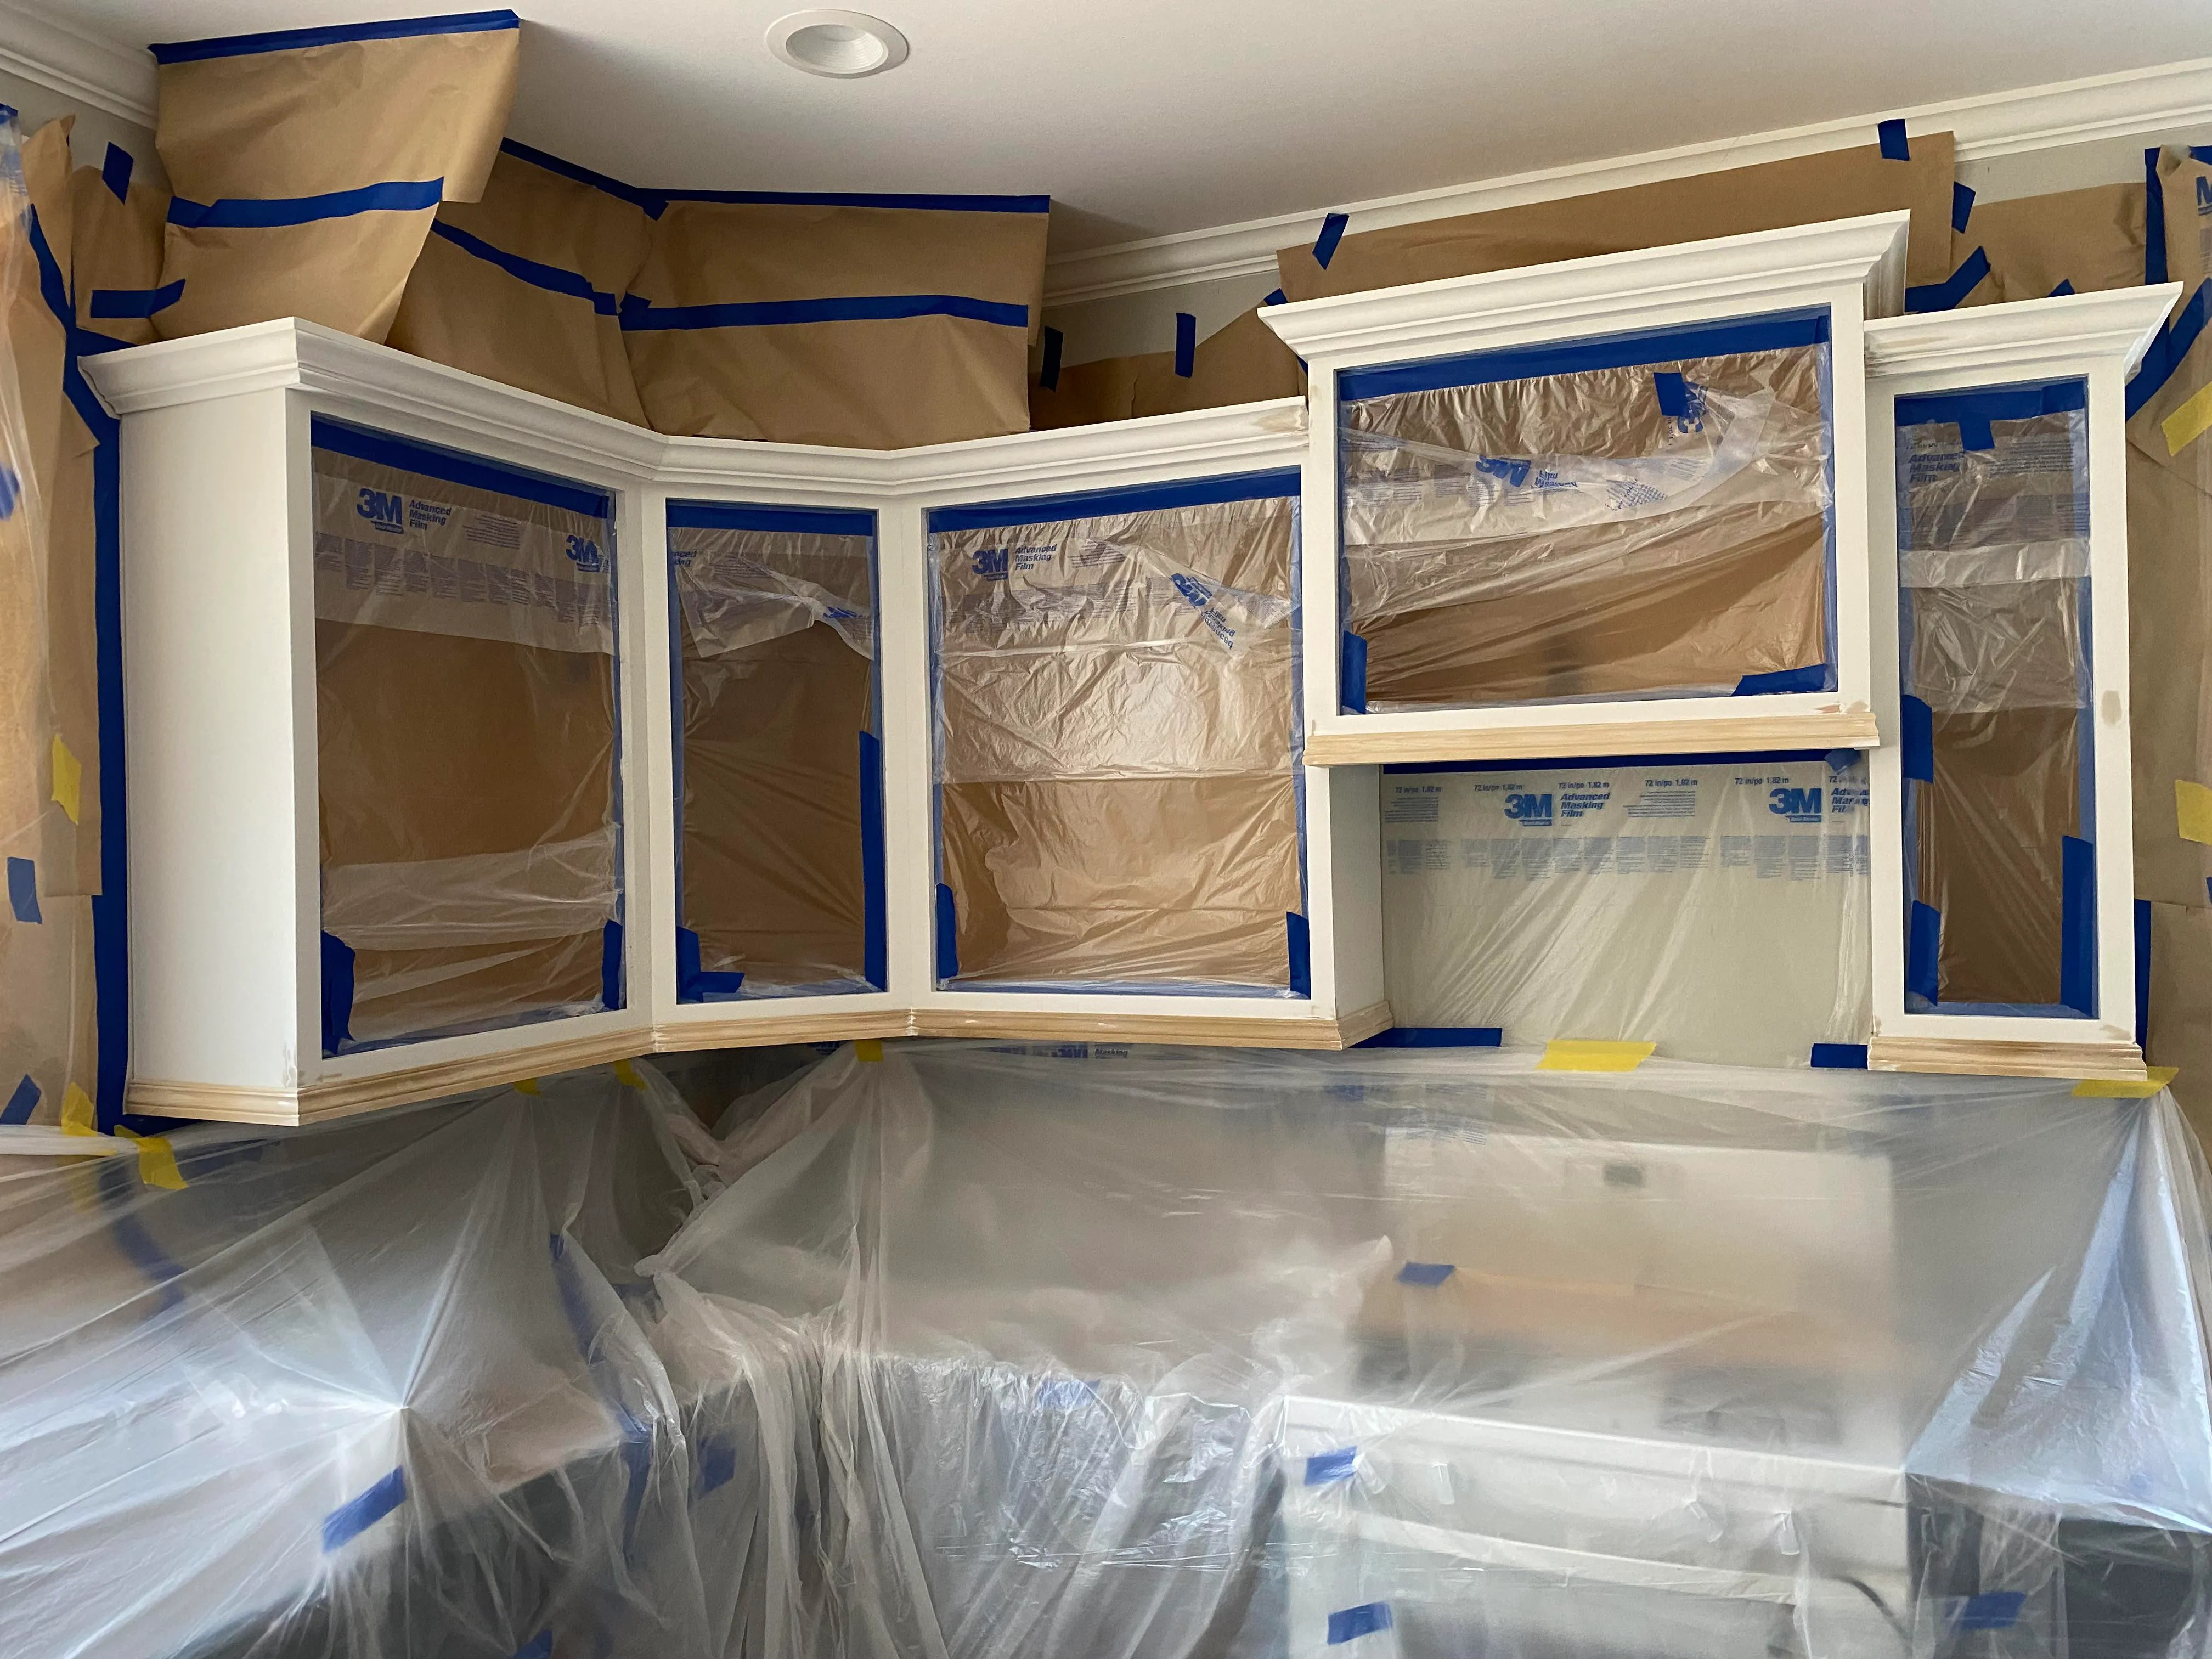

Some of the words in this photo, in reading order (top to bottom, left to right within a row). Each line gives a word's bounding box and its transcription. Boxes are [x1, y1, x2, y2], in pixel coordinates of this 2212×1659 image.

[1909, 462, 1960, 473] Masking
[1909, 473, 1938, 483] Film
[357, 488, 403, 525] 3M
[409, 500, 452, 516] Advanced
[409, 509, 447, 526] Masking
[410, 519, 428, 531] Film
[1015, 544, 1057, 554] Advanced
[972, 548, 1009, 574] 3M
[1015, 554, 1052, 562] Masking
[1745, 777, 1762, 786] in/po
[1560, 792, 1611, 801] Advanced
[1769, 788, 1822, 814] 3M
[1504, 794, 1552, 819] 3M
[1561, 802, 1604, 810] Masking
